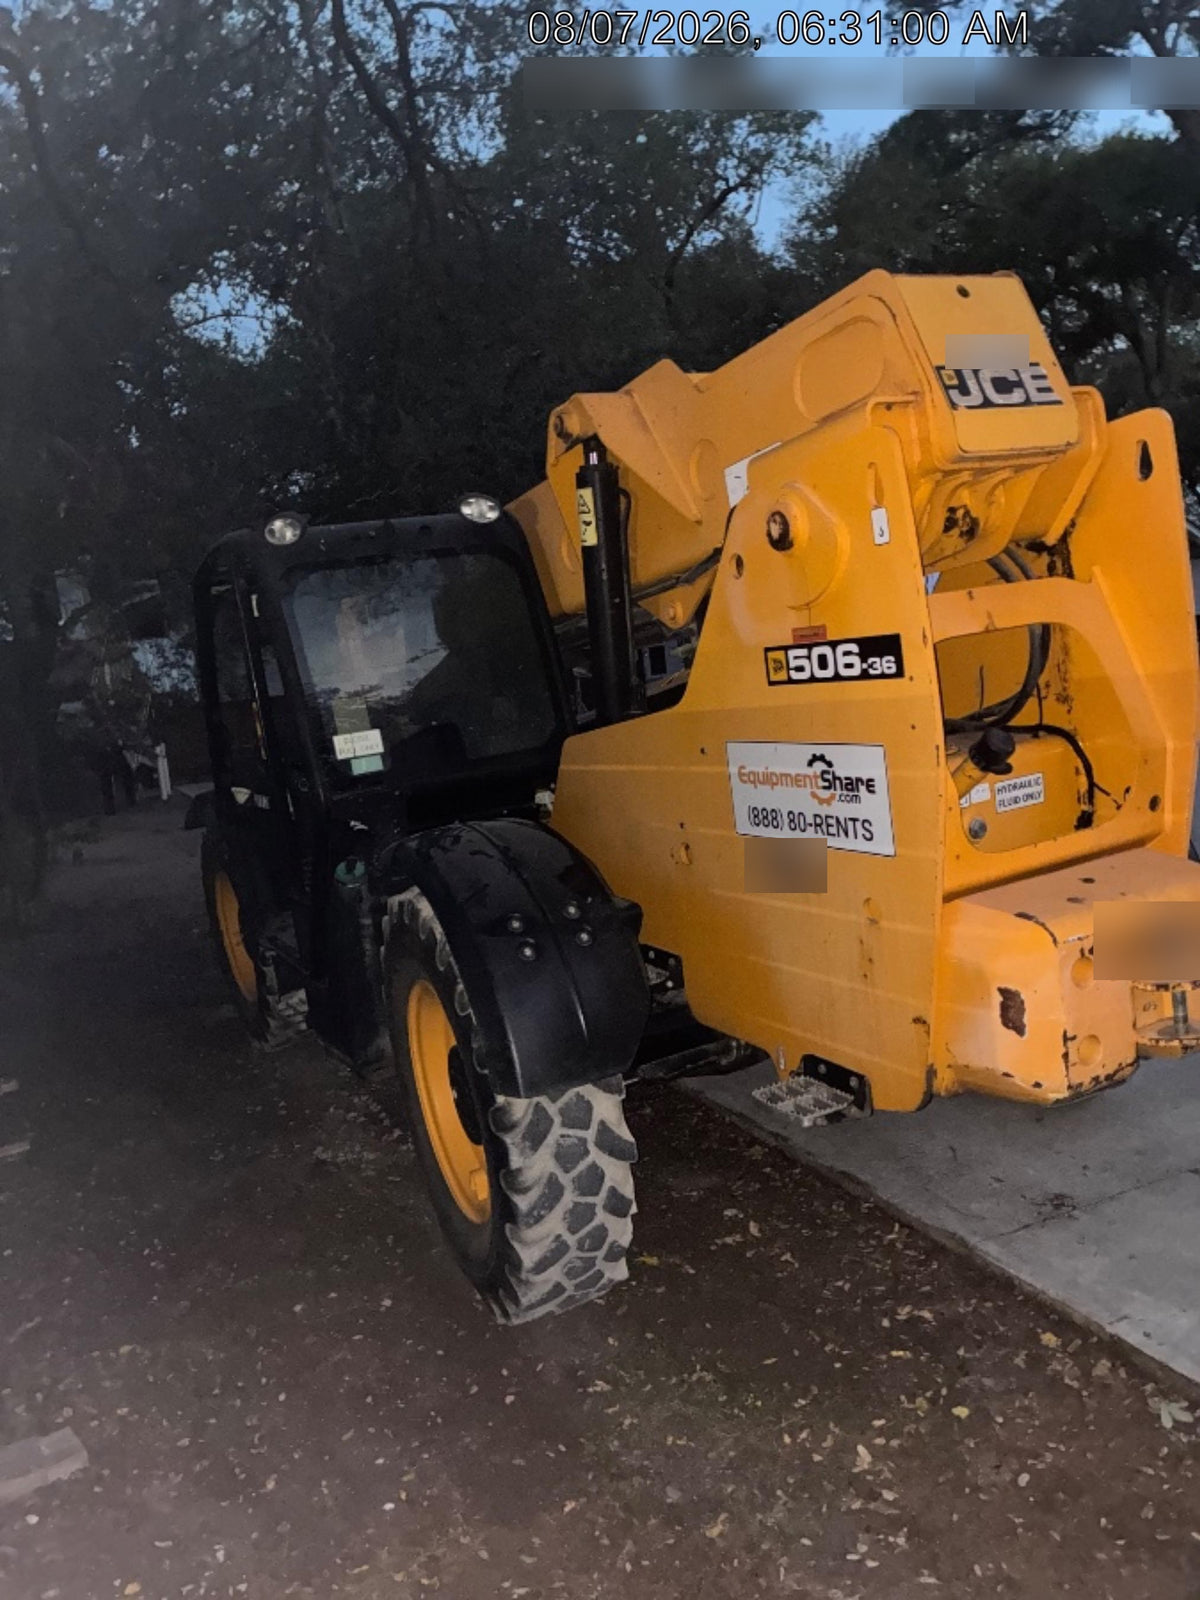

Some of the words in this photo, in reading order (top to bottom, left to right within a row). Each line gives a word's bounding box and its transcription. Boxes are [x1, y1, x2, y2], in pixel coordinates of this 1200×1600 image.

[787, 643, 897, 680] 506-36
[997, 776, 1042, 796] HYDRAULIC
[837, 792, 862, 805] .com
[998, 796, 1021, 809] FLUID
[1022, 790, 1043, 804] ONLY
[748, 805, 784, 832] (888)
[787, 809, 875, 842] 80-RENTS
